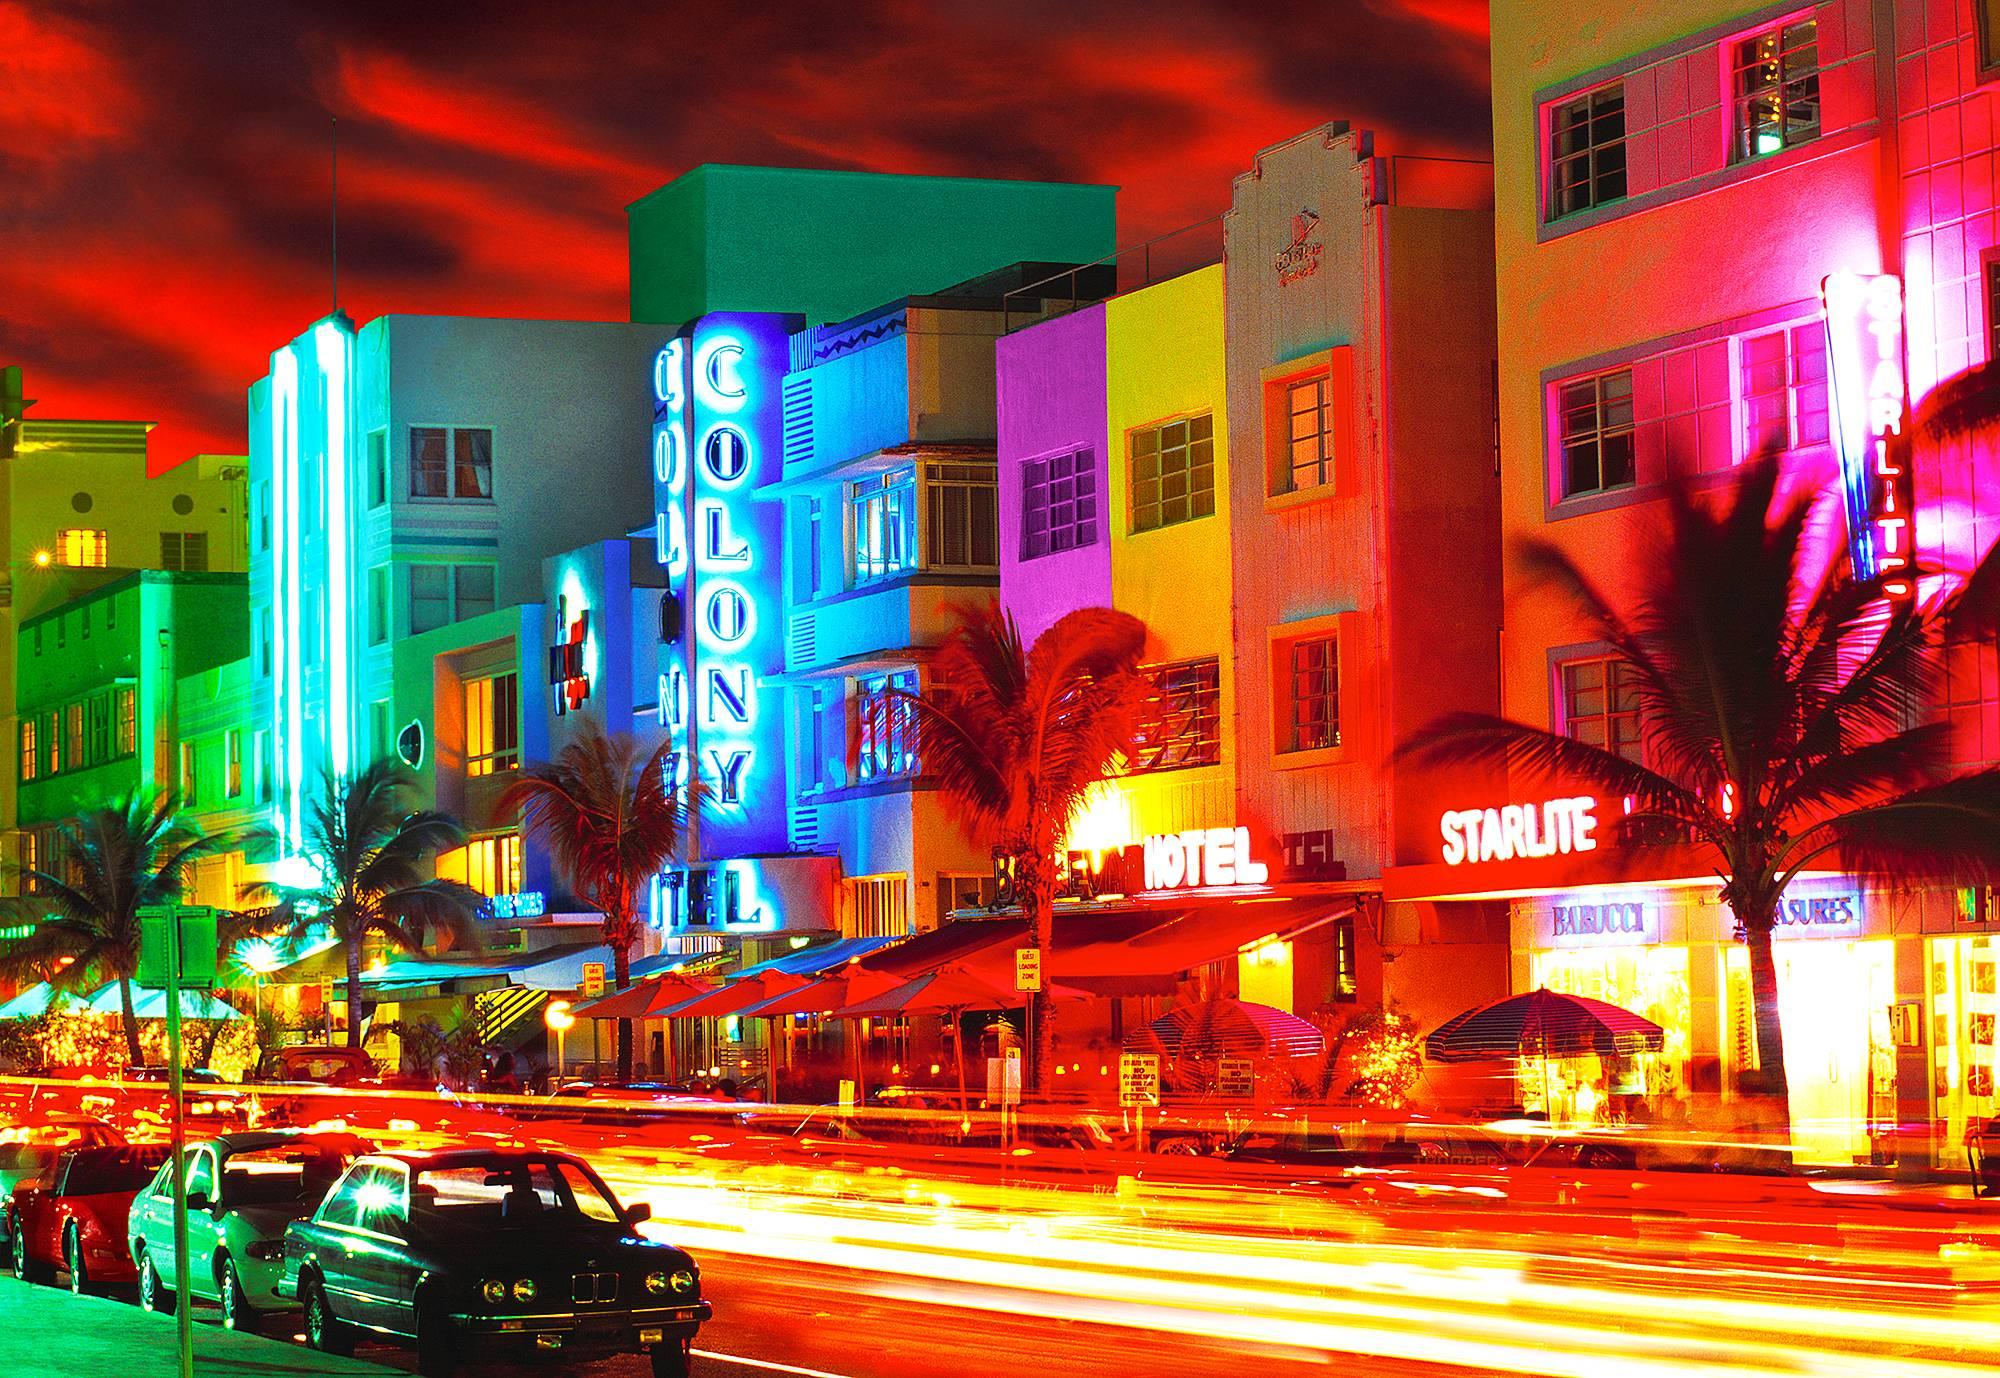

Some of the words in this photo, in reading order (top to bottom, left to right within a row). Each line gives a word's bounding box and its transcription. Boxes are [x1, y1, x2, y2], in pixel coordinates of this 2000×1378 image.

[706, 344, 752, 804] COLONY
[1143, 825, 1269, 891] HOTEL
[1440, 795, 1598, 866] STARLITE
[1552, 902, 1645, 937] BARUCCI
